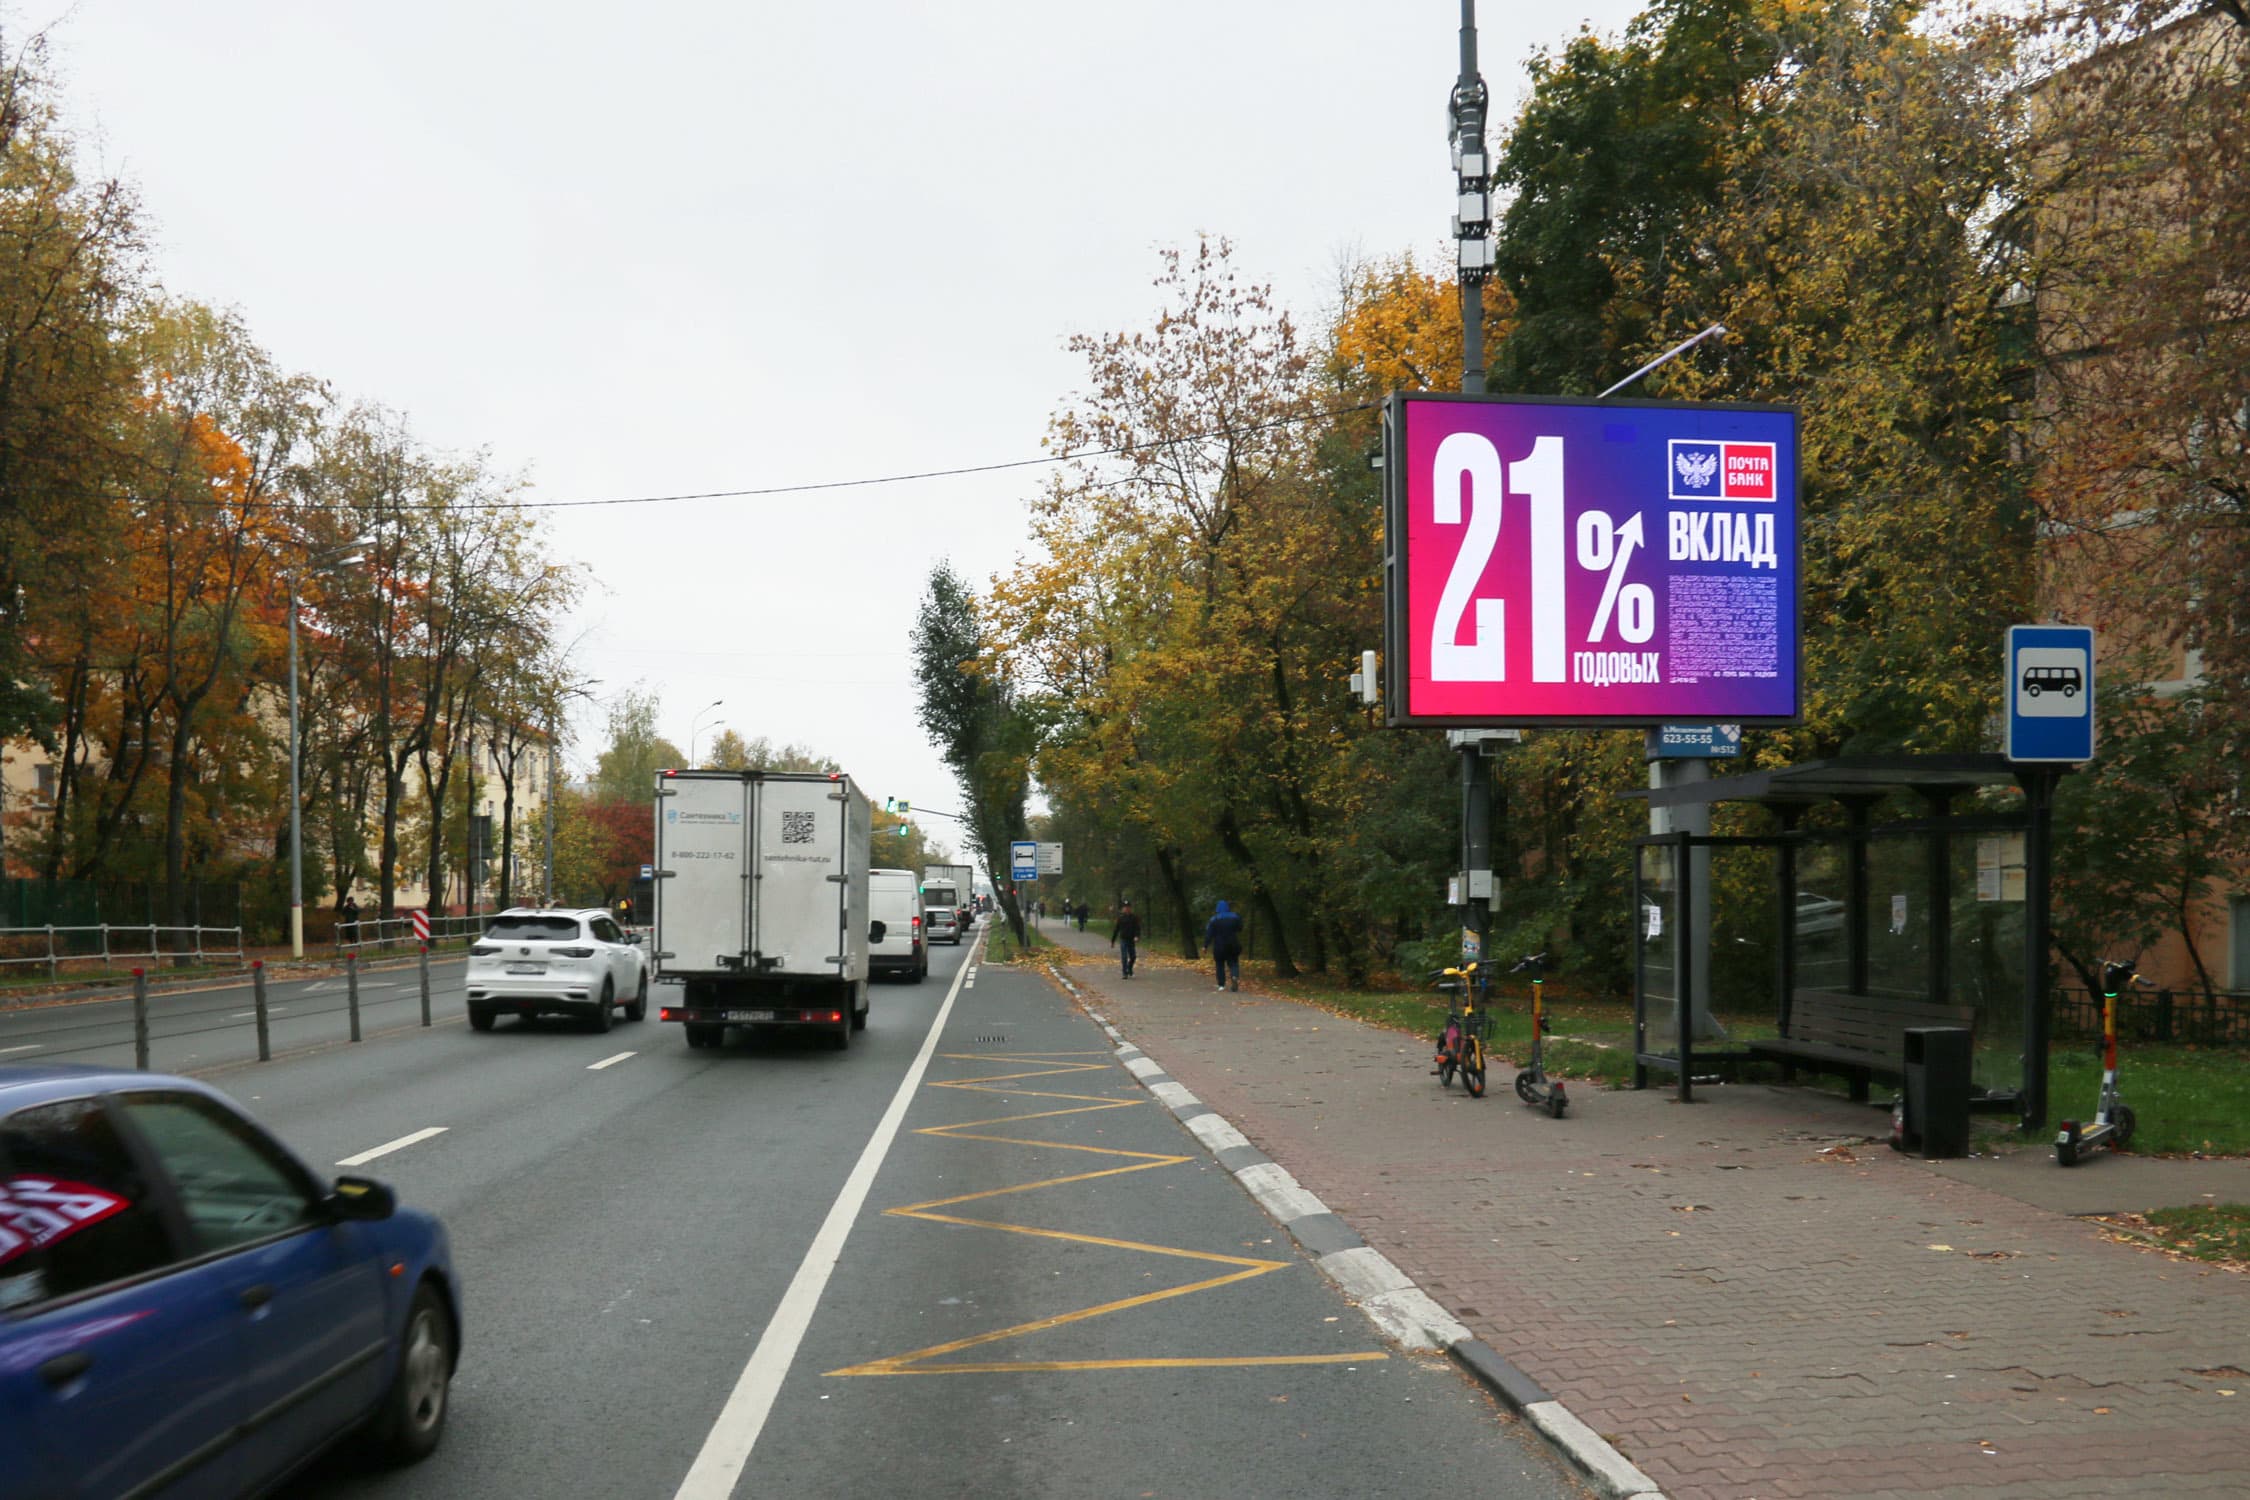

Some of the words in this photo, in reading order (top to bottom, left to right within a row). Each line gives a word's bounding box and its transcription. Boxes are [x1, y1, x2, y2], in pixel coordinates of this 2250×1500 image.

[1728, 456, 1769, 471] ПОЧТА
[1728, 472, 1764, 487] БАНК
[1668, 511, 1778, 569] ВКЛАД
[1573, 651, 1660, 687] ГОДОВЫХ
[1663, 734, 1713, 744] 623-55-55
